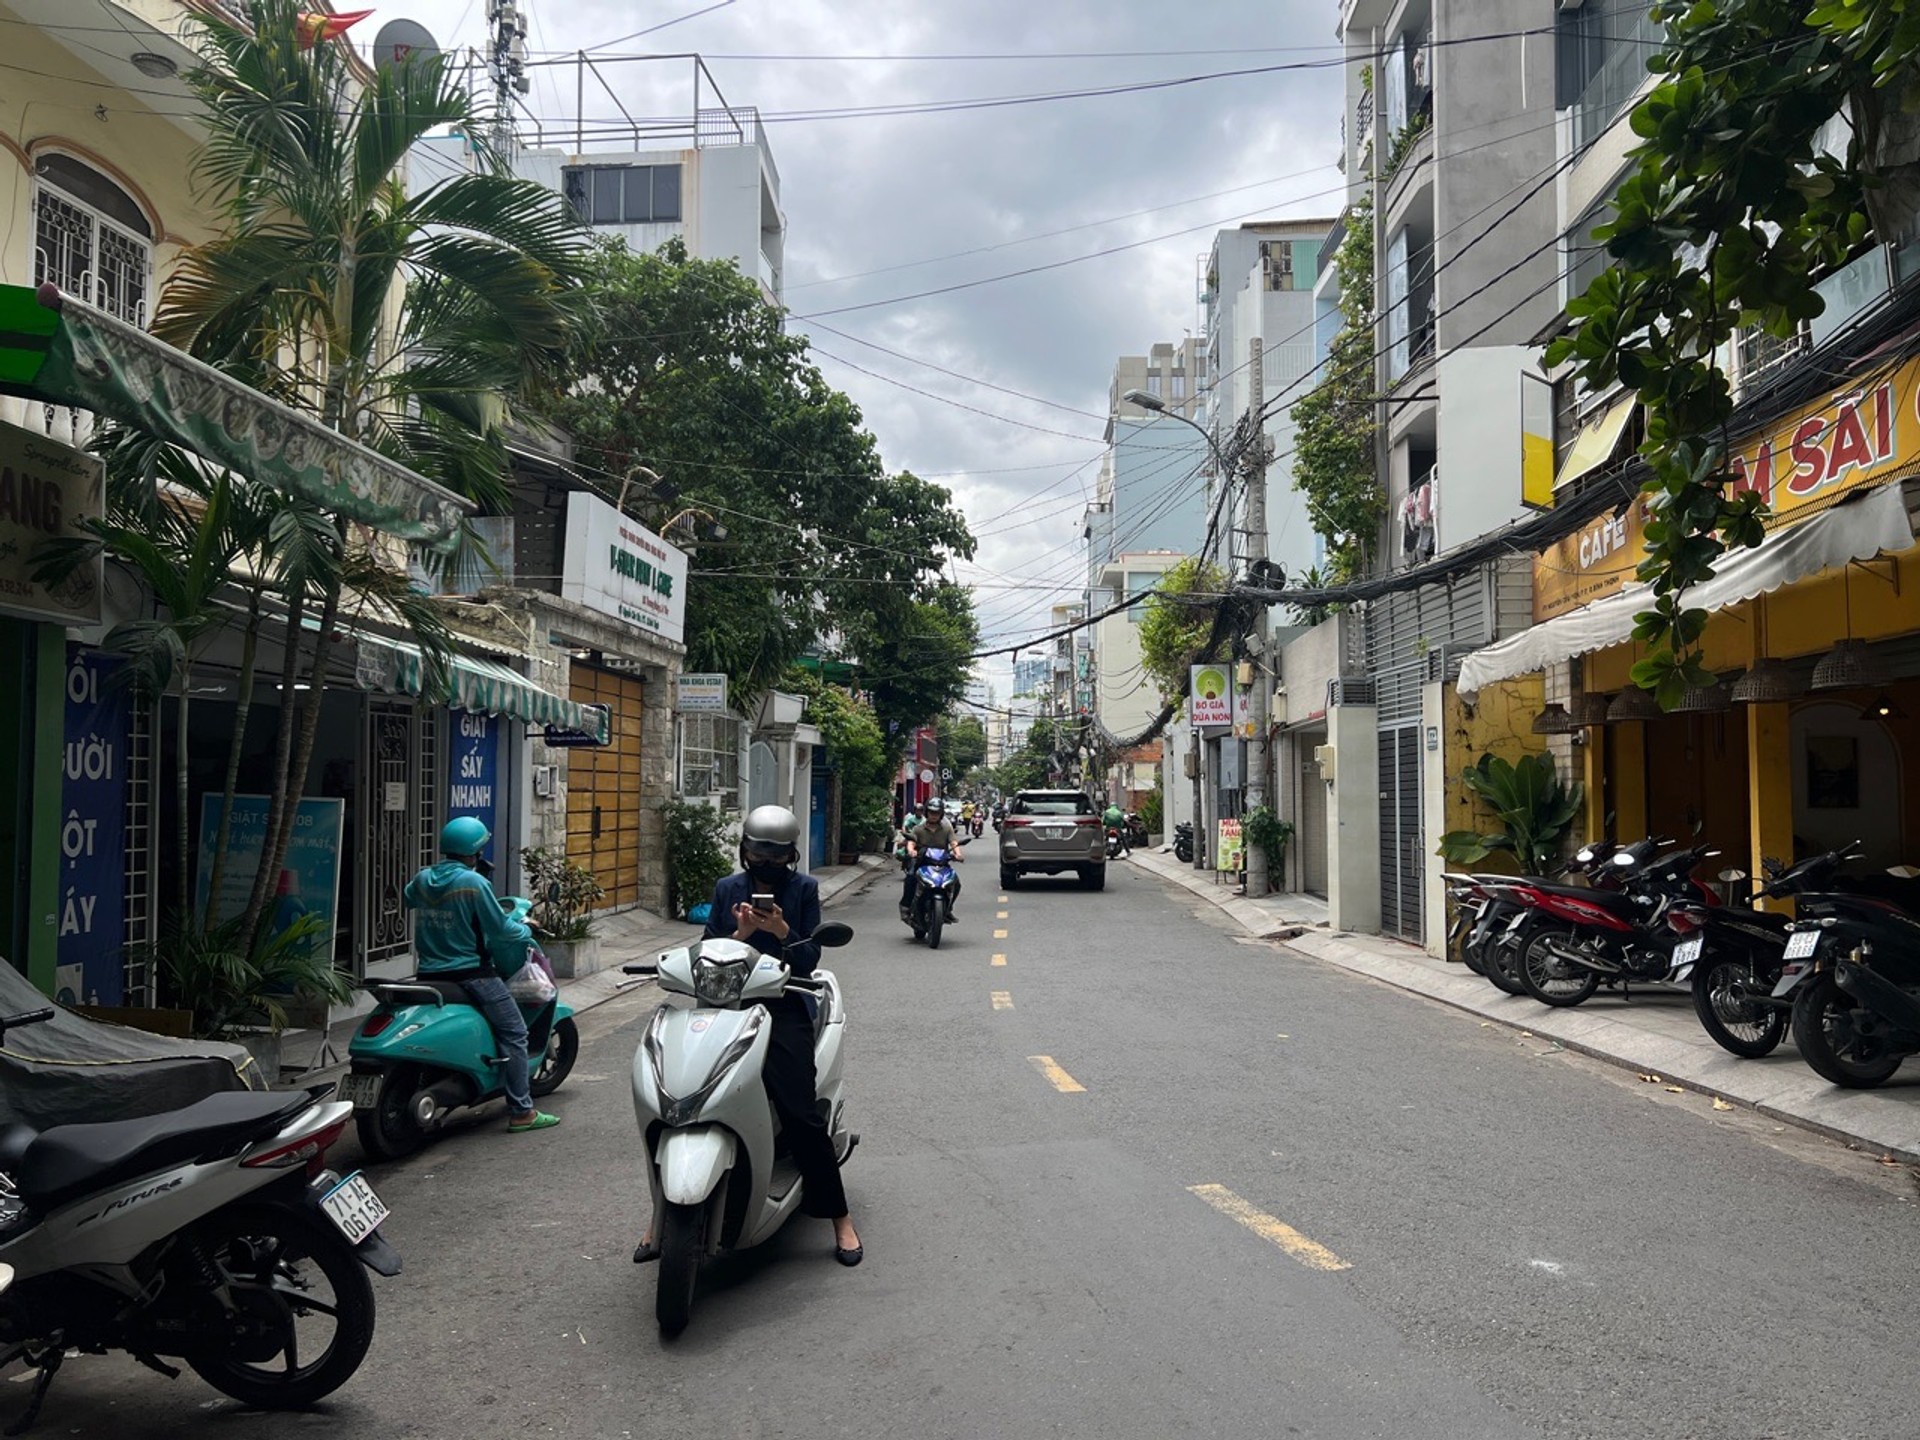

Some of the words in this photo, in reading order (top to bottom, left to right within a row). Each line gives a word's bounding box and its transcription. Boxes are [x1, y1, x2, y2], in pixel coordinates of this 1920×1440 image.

[451, 784, 492, 808] NHANH
[101, 1177, 183, 1218] FUTURE
[328, 1177, 369, 1217] 71-AE
[343, 1196, 385, 1238] 061.58
